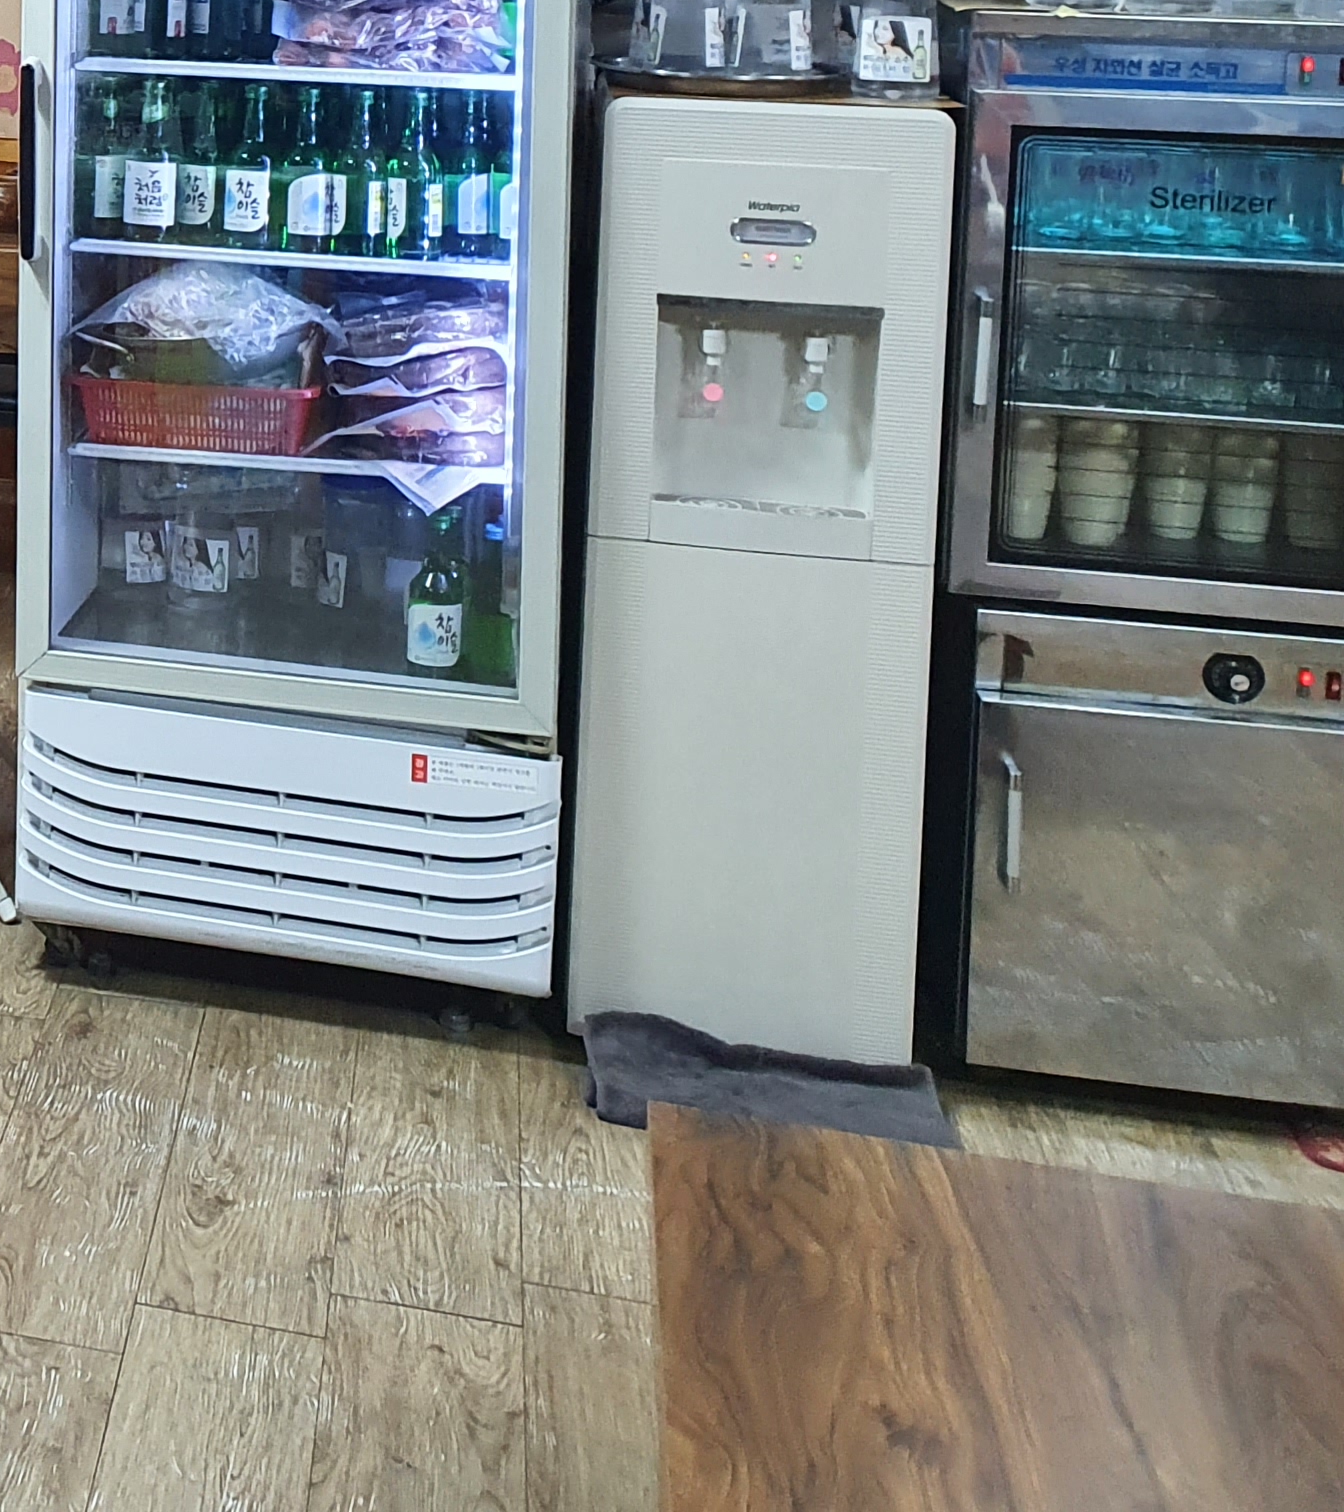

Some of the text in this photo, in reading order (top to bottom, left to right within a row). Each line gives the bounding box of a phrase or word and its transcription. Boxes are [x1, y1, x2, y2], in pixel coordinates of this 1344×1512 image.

[235, 177, 255, 199] 참
[236, 198, 261, 220] 이슬
[1150, 186, 1277, 215] Sterilizer
[435, 612, 454, 634] 참
